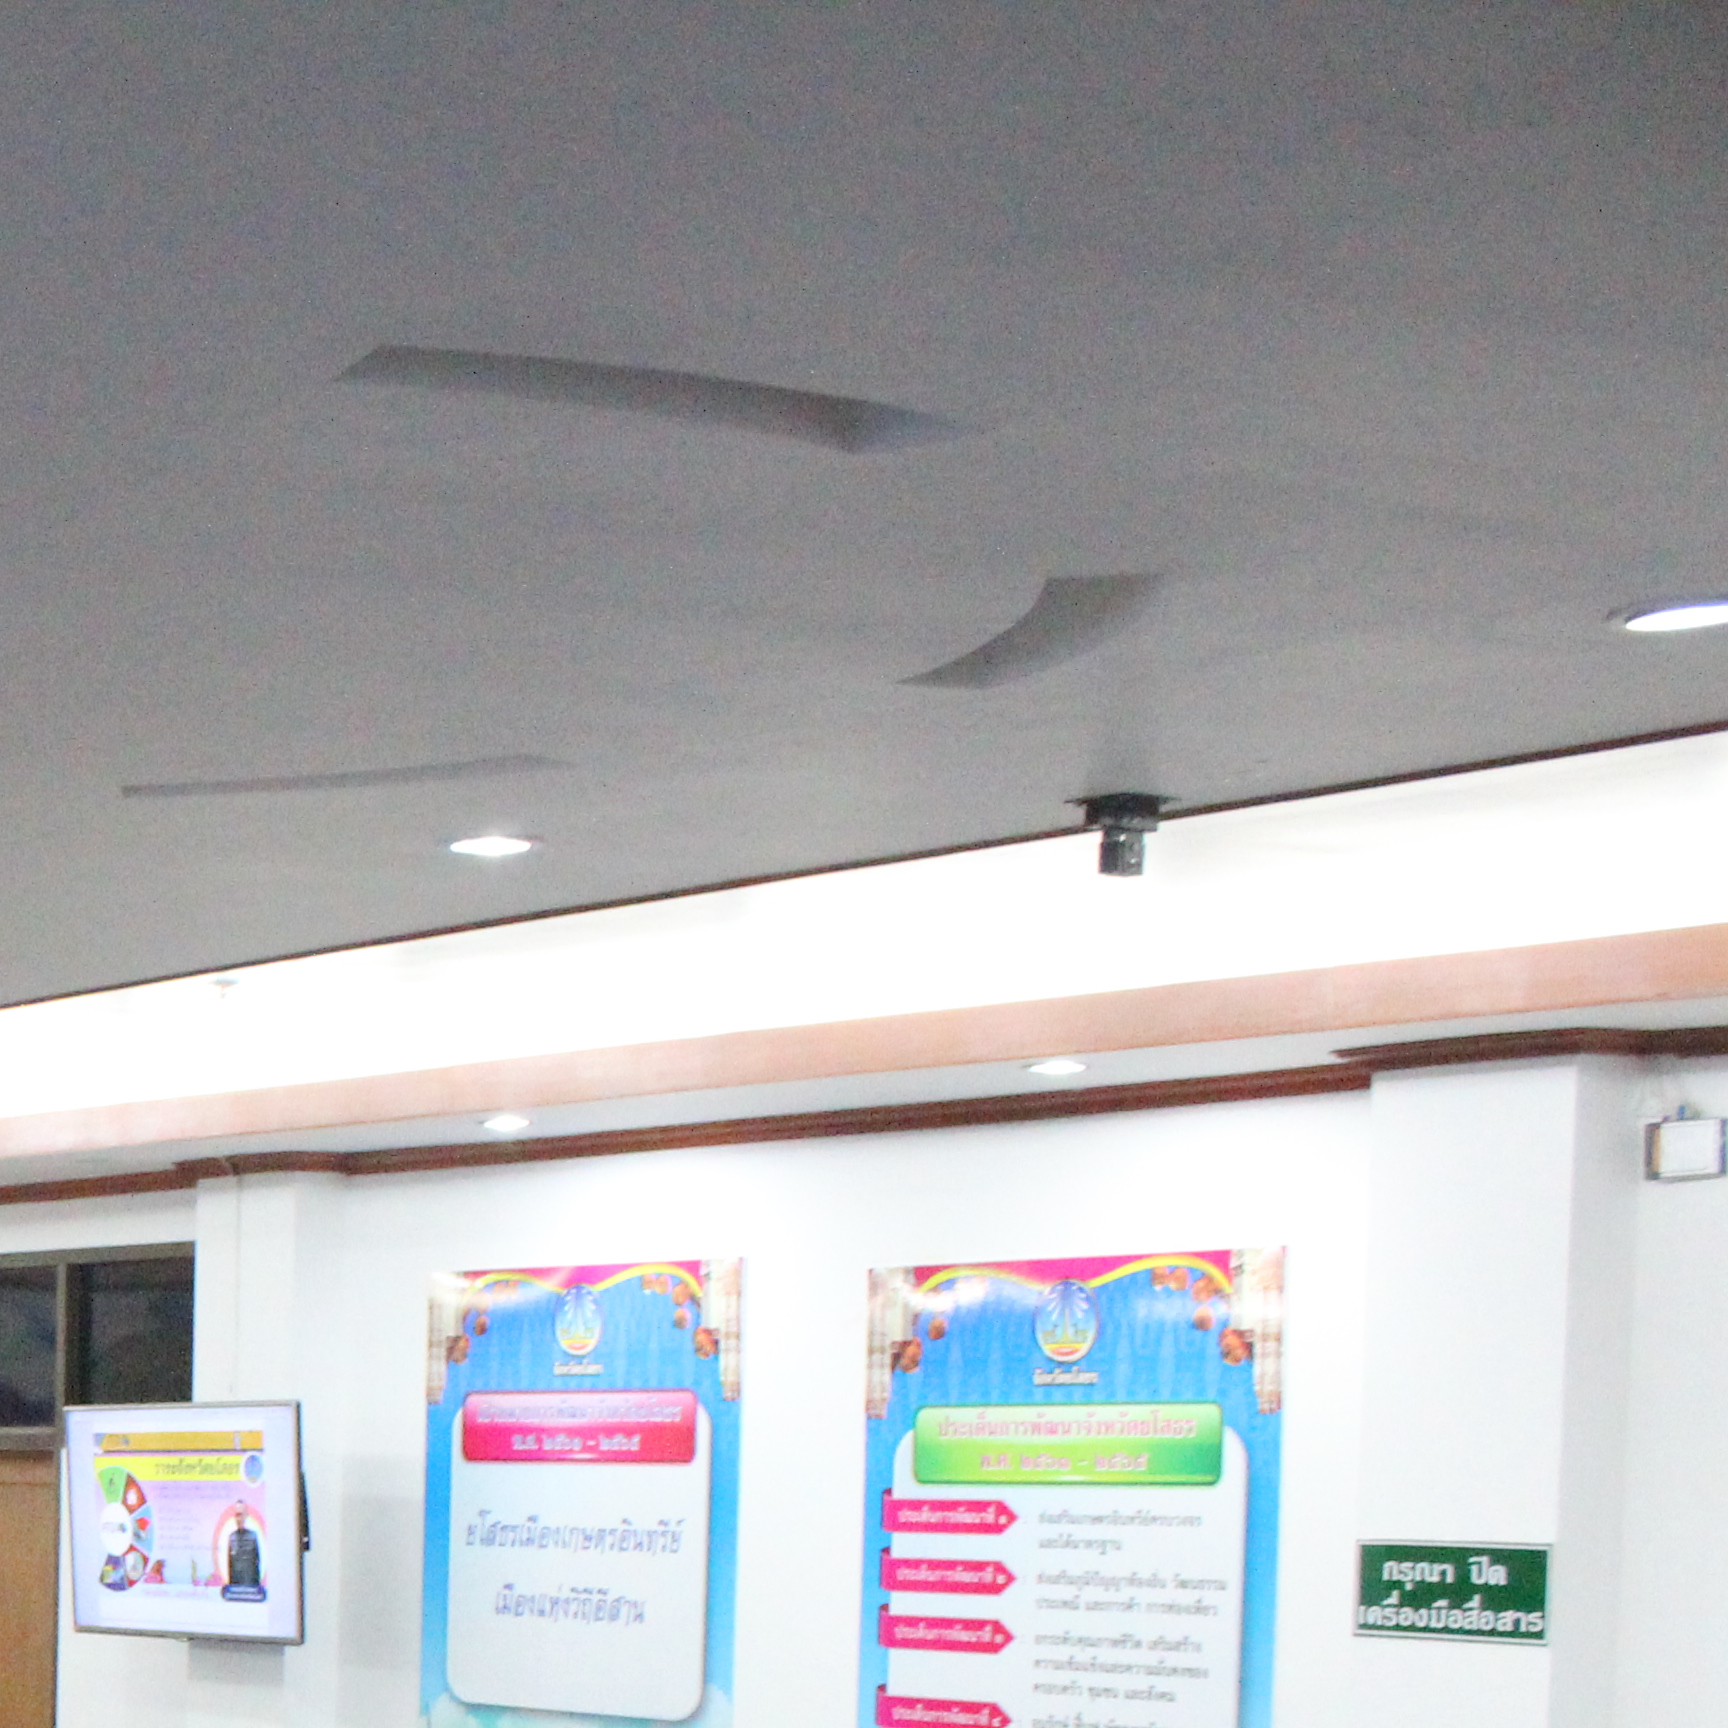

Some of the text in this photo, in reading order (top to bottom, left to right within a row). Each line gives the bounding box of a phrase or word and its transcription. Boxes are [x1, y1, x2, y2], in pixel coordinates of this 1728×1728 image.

[465, 1508, 686, 1556] ยโสธรเมืองเกษตรอินทรีย์
[1381, 1555, 1509, 1591] กรุณา ปิด
[493, 1582, 648, 1627] เมืองแห่งวิถีอีสาน
[1357, 1589, 1544, 1633] เครื่องมือสื่อสาร
